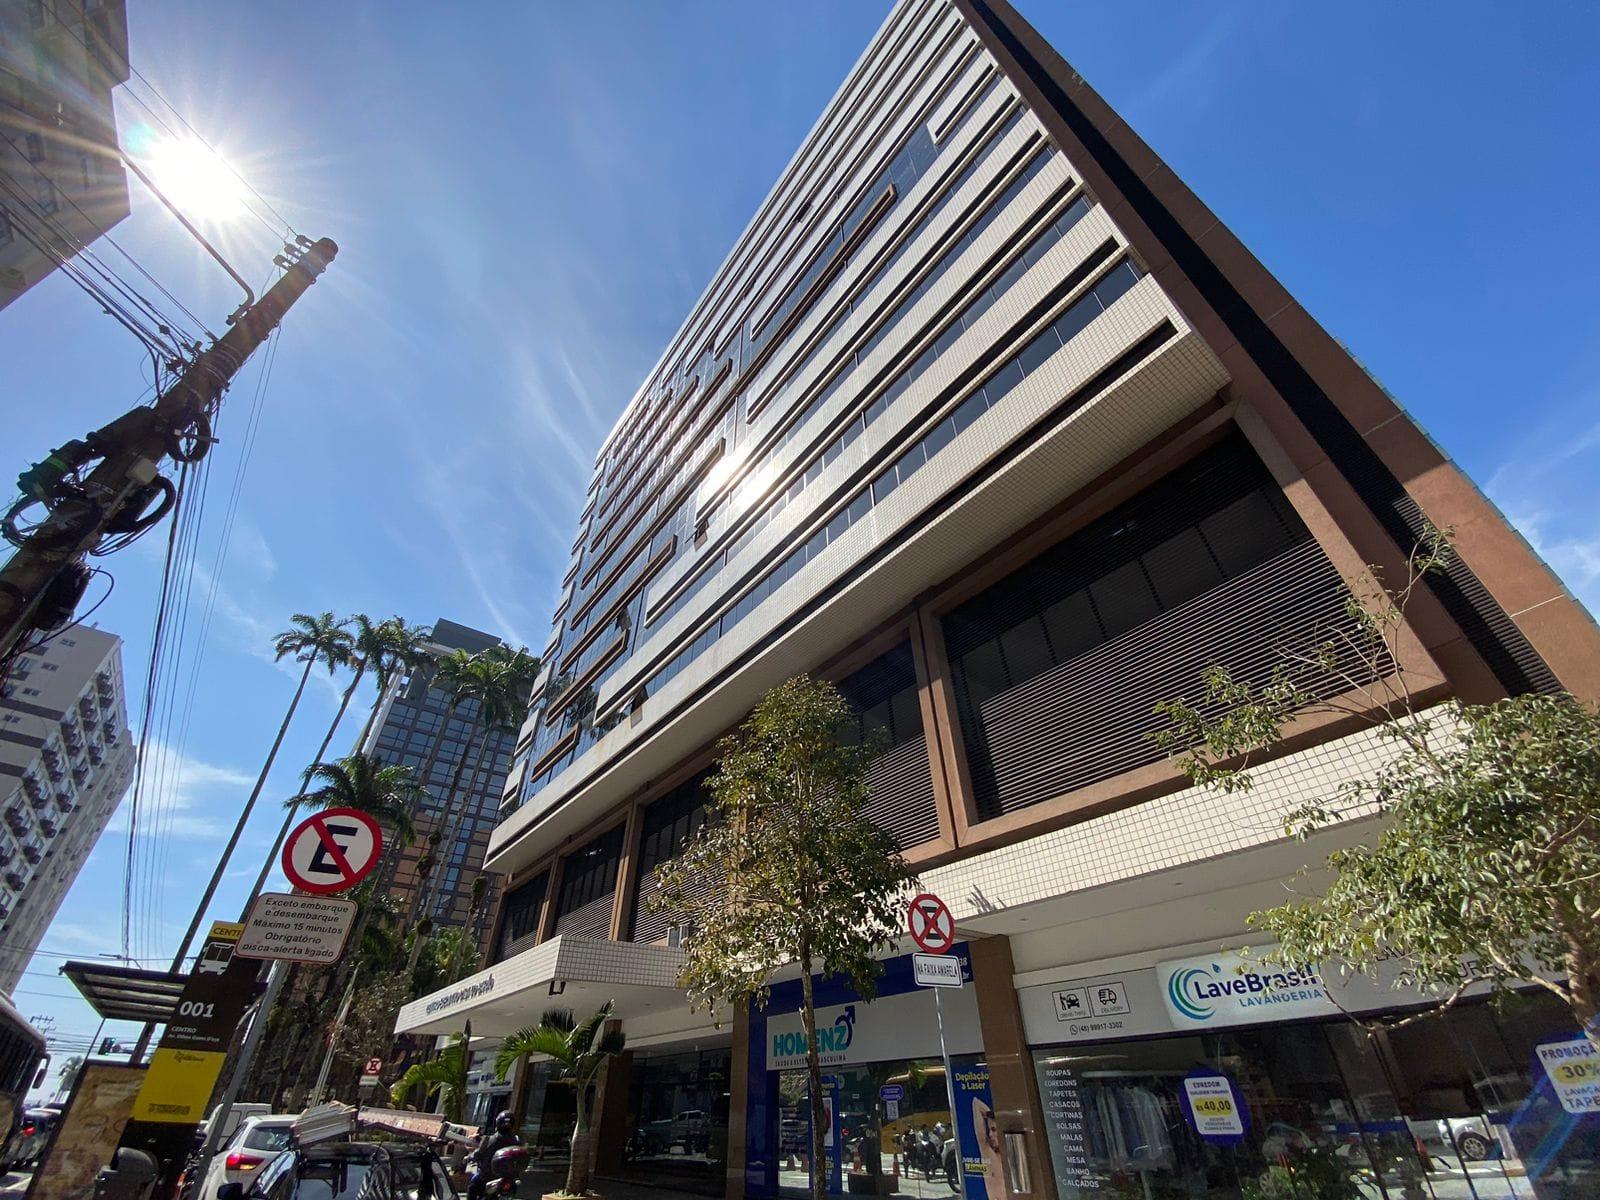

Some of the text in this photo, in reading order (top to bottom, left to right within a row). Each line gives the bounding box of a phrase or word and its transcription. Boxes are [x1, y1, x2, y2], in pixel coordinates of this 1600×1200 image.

[265, 898, 349, 913] Exceto embarque
[273, 910, 340, 922] desembarque
[294, 922, 303, 930] 15
[305, 924, 343, 934] minutos
[265, 932, 322, 944] Obrigatório
[1194, 963, 1317, 999] LaveBrasil
[1239, 989, 1322, 1007] LAVANDERIA
[180, 1001, 215, 1018] 001
[171, 1025, 197, 1033] CENTRO
[1051, 1111, 1083, 1119] CORTINAS
[1056, 1122, 1082, 1130] BOLSAS
[1060, 1133, 1083, 1141] MALAS
[1066, 1156, 1086, 1164] MESA
[1066, 1167, 1089, 1175] BANHO
[1062, 1179, 1099, 1188] CALÇADOS
